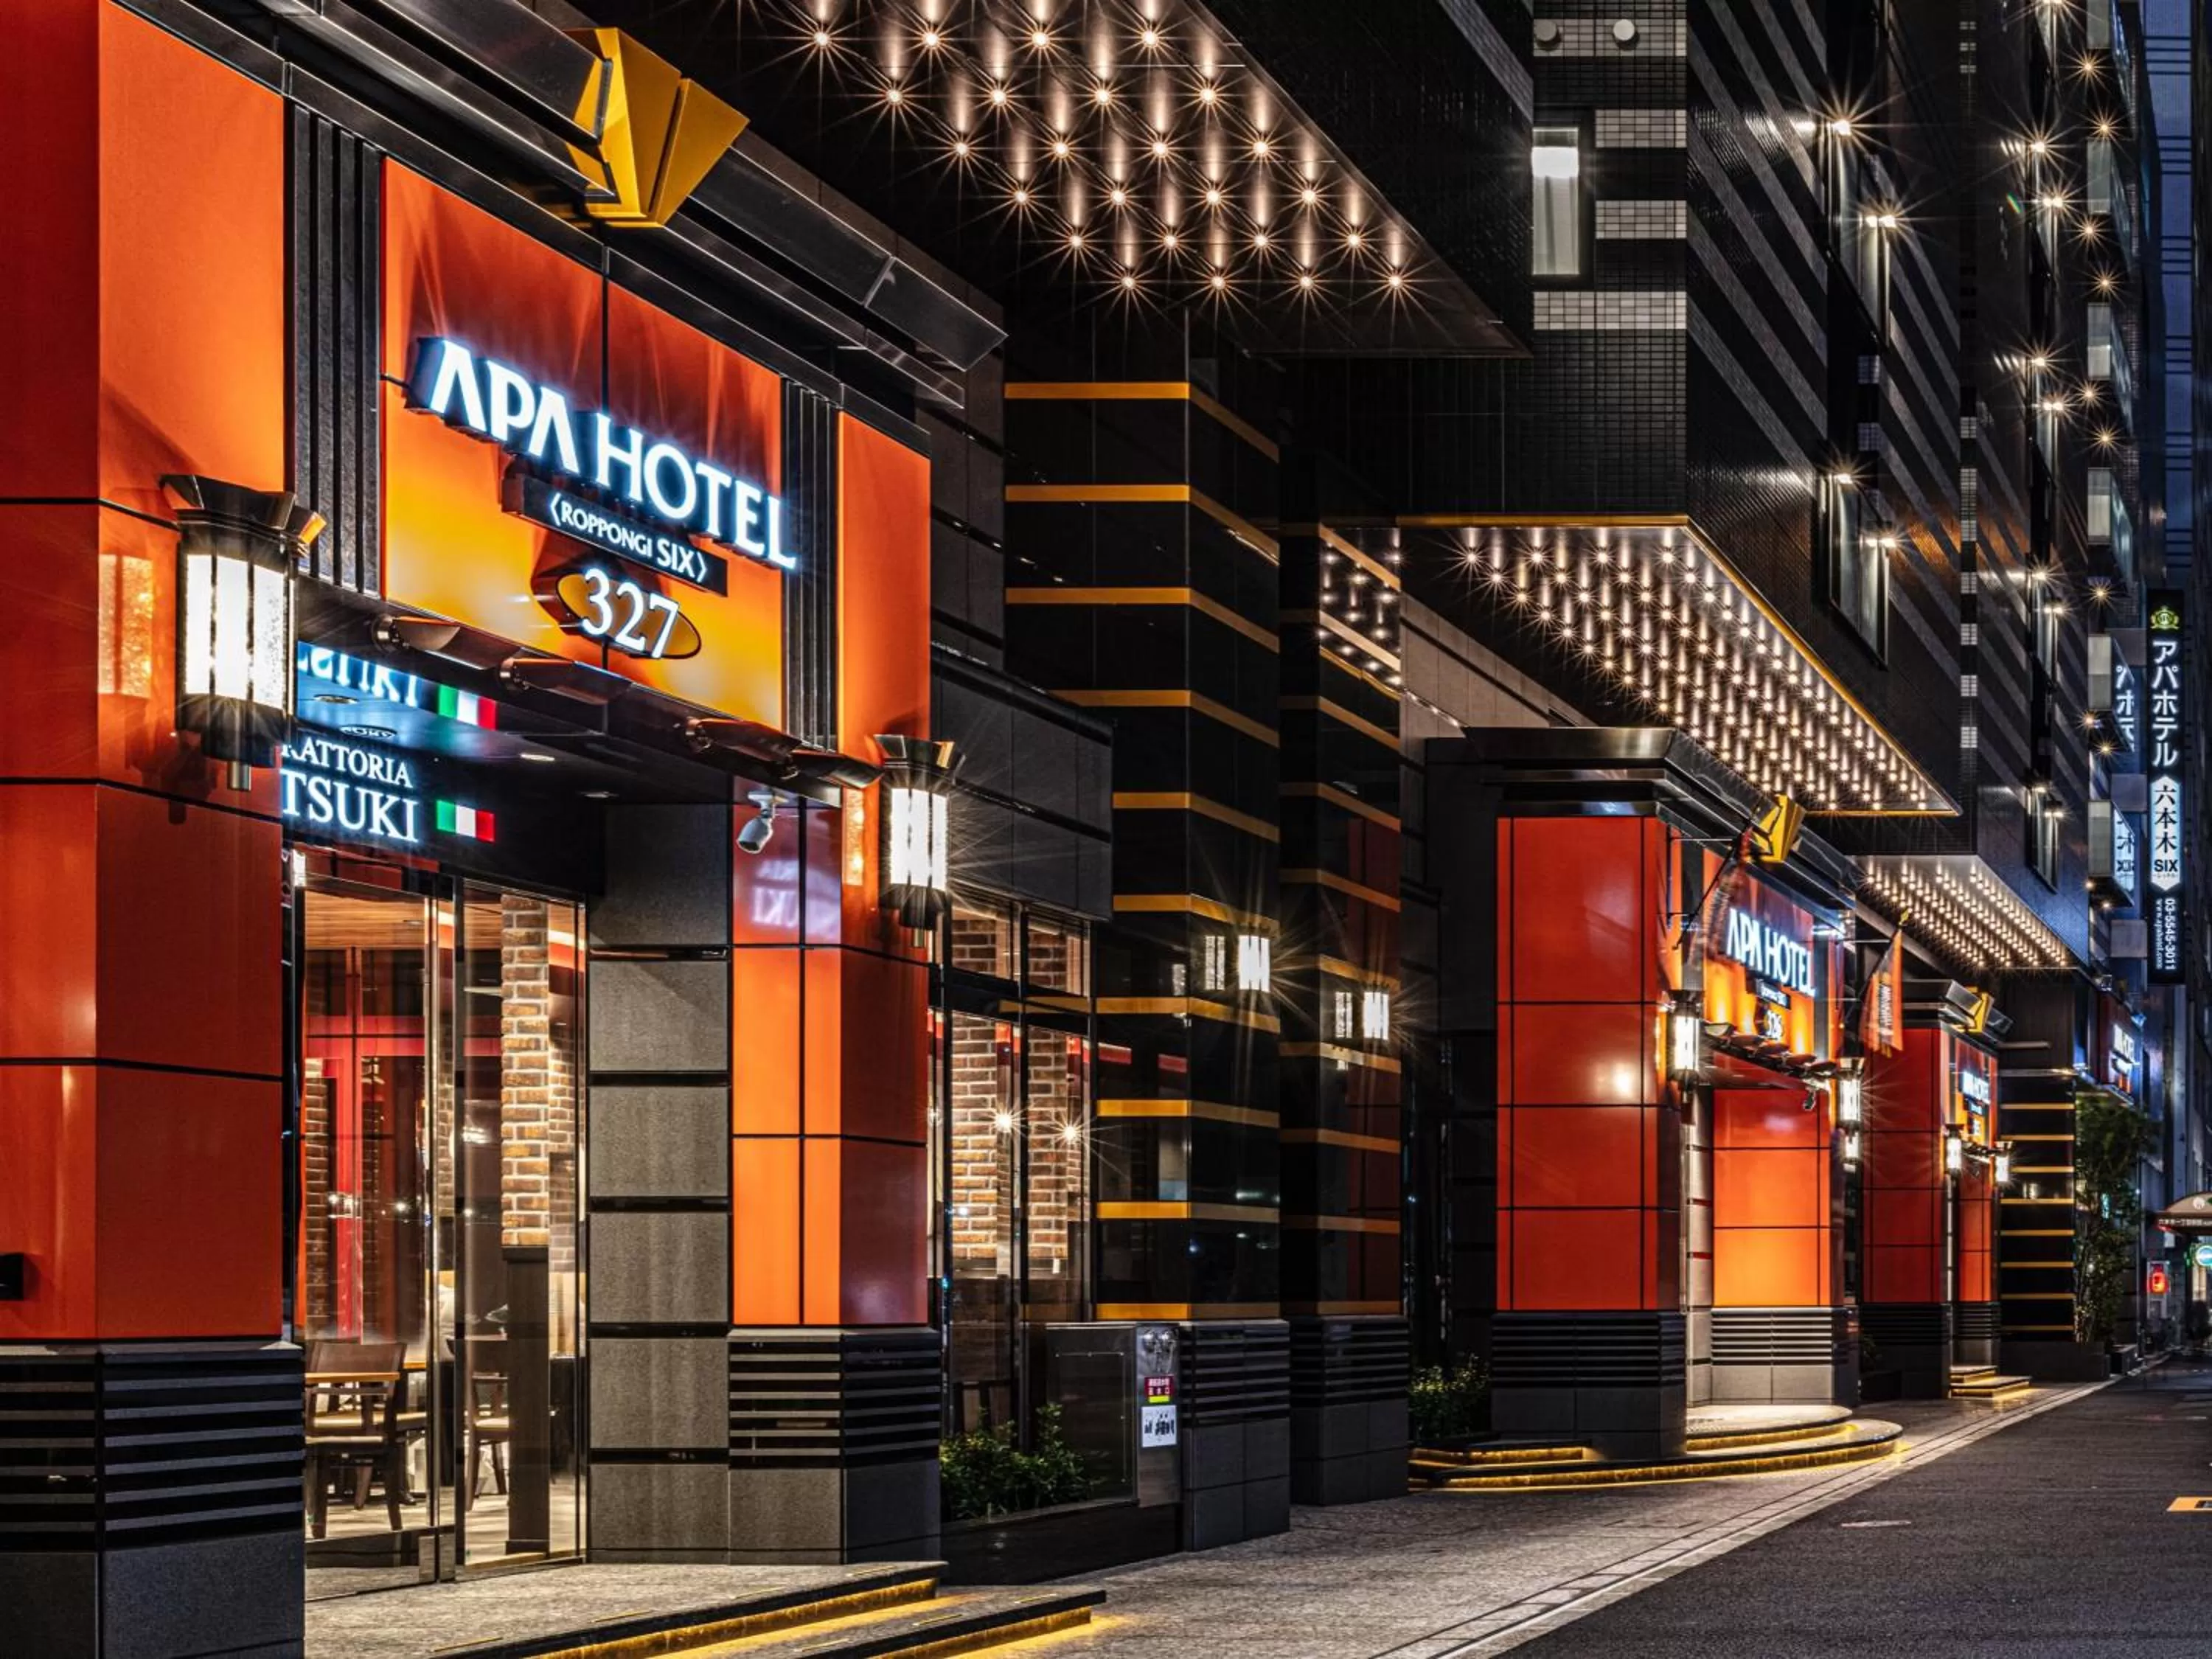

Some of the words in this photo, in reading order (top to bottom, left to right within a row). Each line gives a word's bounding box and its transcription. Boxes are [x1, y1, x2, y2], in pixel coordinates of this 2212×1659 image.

[429, 340, 580, 473] APA
[595, 412, 796, 570] HOTEL
[582, 568, 679, 658] 327
[2152, 641, 2178, 767] アパホテル
[279, 768, 419, 843] TSUKI
[2154, 785, 2177, 853] 六本木
[2154, 859, 2178, 872] SIX
[1726, 908, 1763, 971] APA
[1764, 927, 1816, 997] HOTEL
